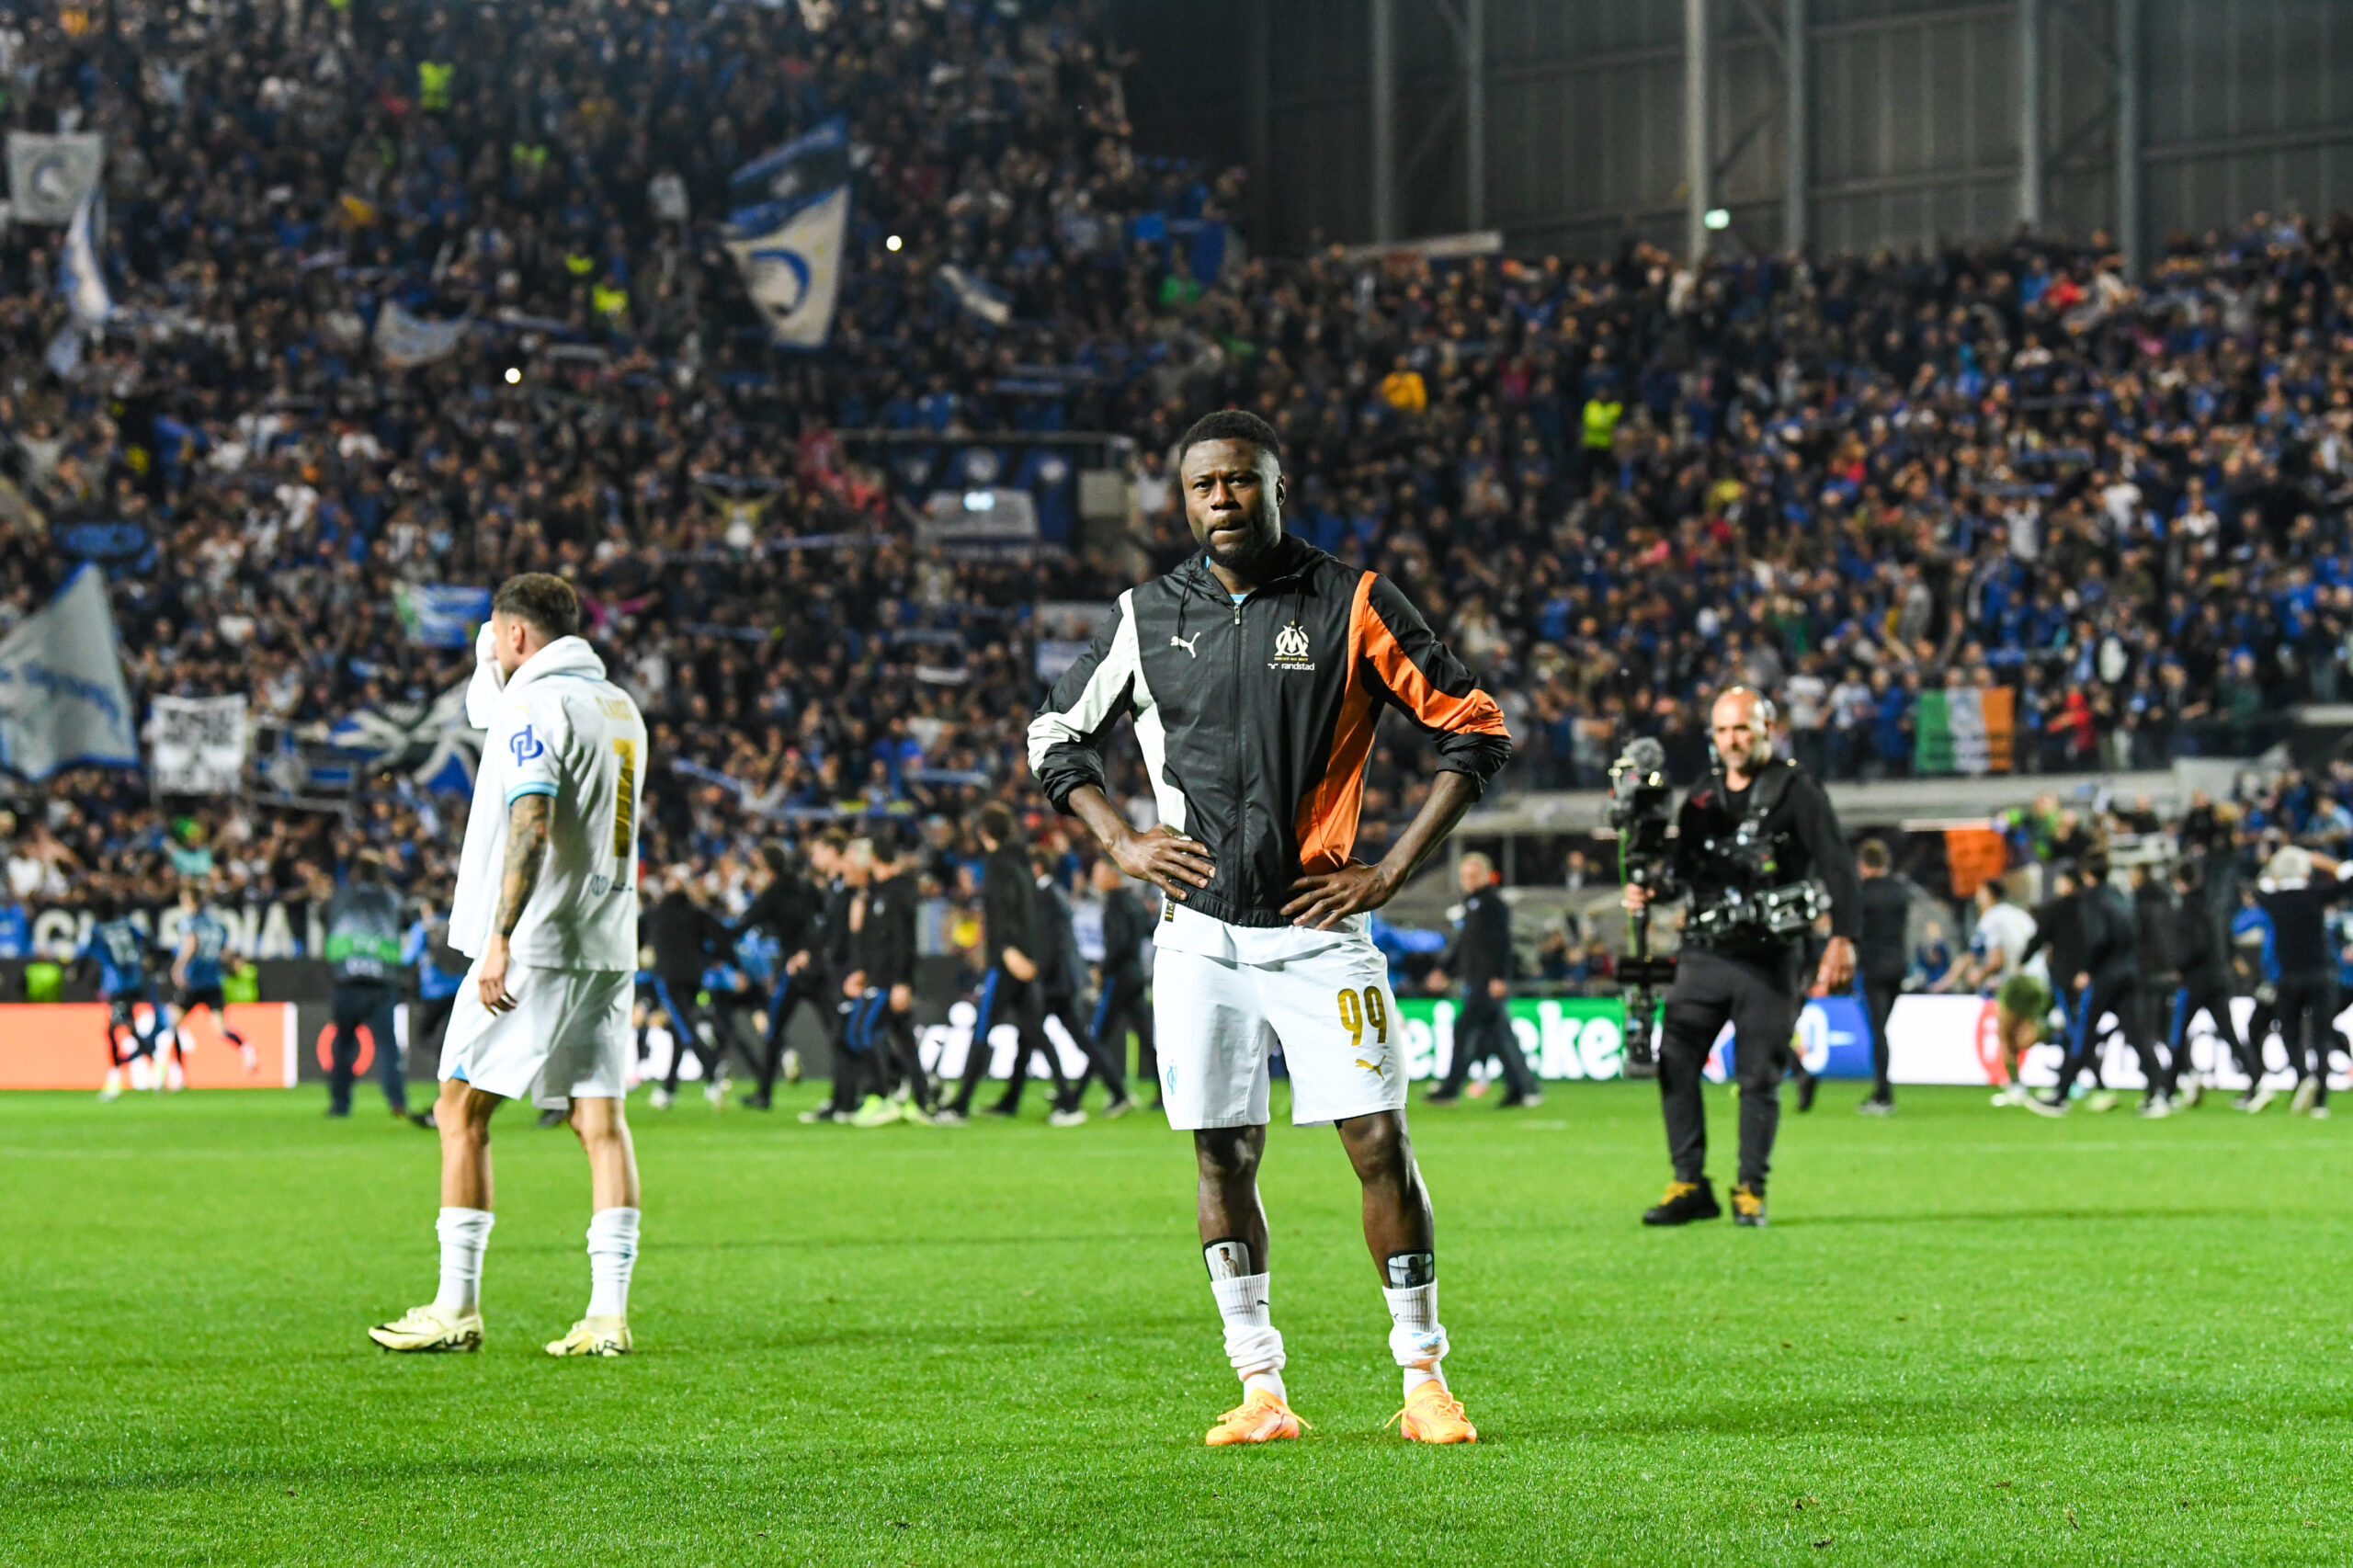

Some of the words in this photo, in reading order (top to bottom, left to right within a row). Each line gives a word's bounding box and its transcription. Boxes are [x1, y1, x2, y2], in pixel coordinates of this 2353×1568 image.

[1281, 662, 1315, 671] randstad
[612, 738, 636, 858] 7
[1337, 985, 1387, 1046] 99
